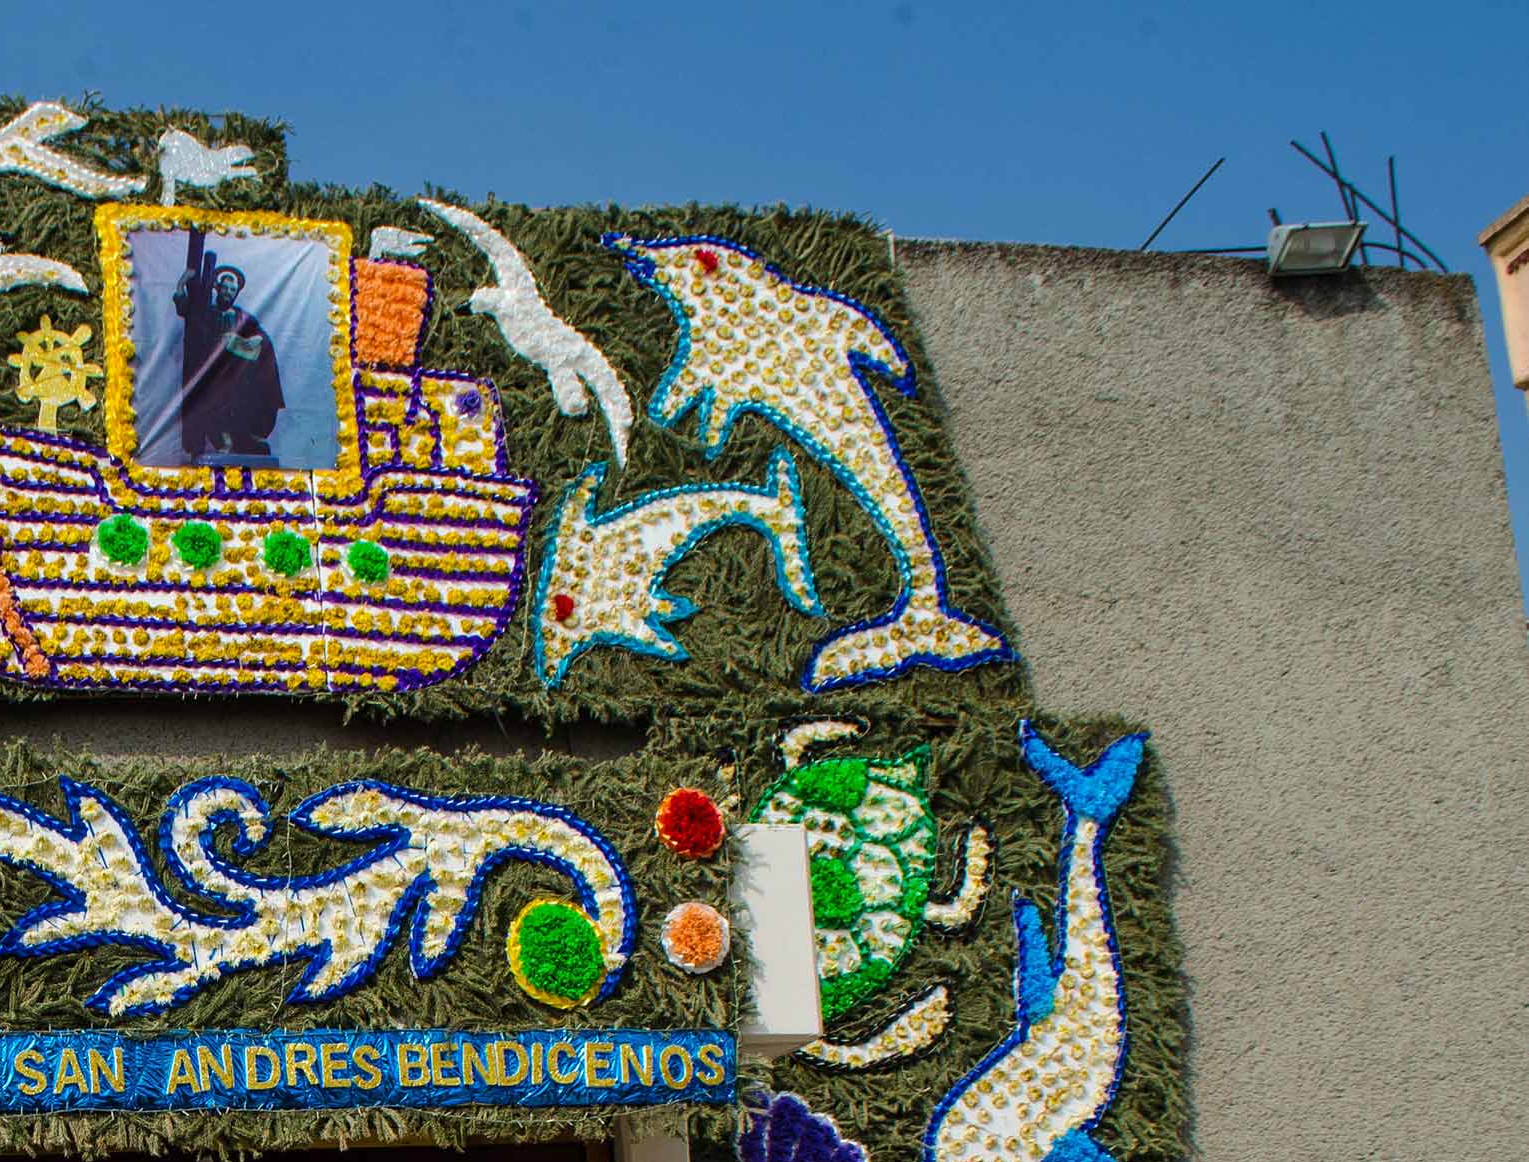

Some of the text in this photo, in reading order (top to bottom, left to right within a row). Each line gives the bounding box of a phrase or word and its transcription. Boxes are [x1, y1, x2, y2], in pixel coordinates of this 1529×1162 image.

[14, 1046, 126, 1098] SAN
[166, 1042, 383, 1095] ANDRES
[397, 1040, 726, 1090] BENDICENOS
